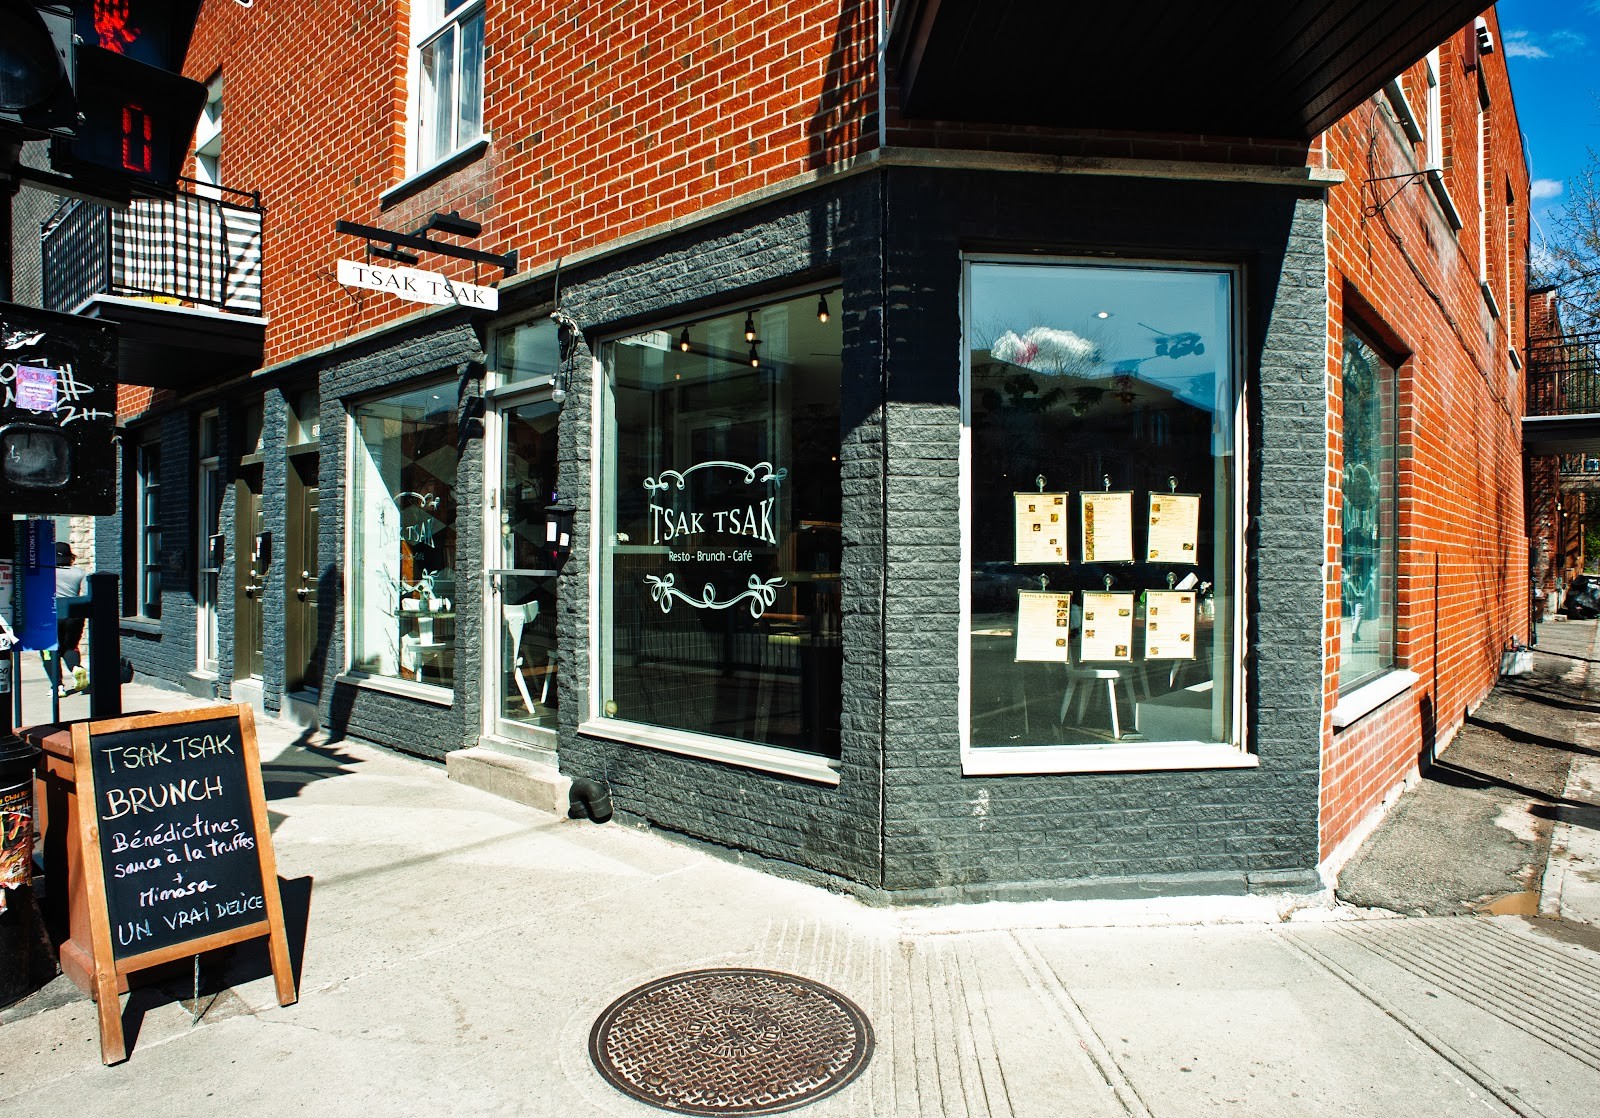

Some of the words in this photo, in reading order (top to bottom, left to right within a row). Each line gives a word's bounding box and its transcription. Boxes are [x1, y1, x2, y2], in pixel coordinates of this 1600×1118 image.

[352, 266, 418, 293] TSAK
[426, 279, 486, 305] TSAK
[649, 502, 706, 545] TSAK
[712, 496, 777, 545] TSAK
[668, 550, 691, 562] Resto
[697, 550, 726, 562] Brunch
[732, 549, 753, 562] Café
[102, 742, 172, 774] TSAK
[173, 734, 235, 761] TSAK
[102, 775, 223, 821] BRUNCH
[111, 813, 240, 854] Bénédictines
[163, 847, 182, 864] à
[183, 843, 207, 862] la
[118, 918, 153, 947] UN
